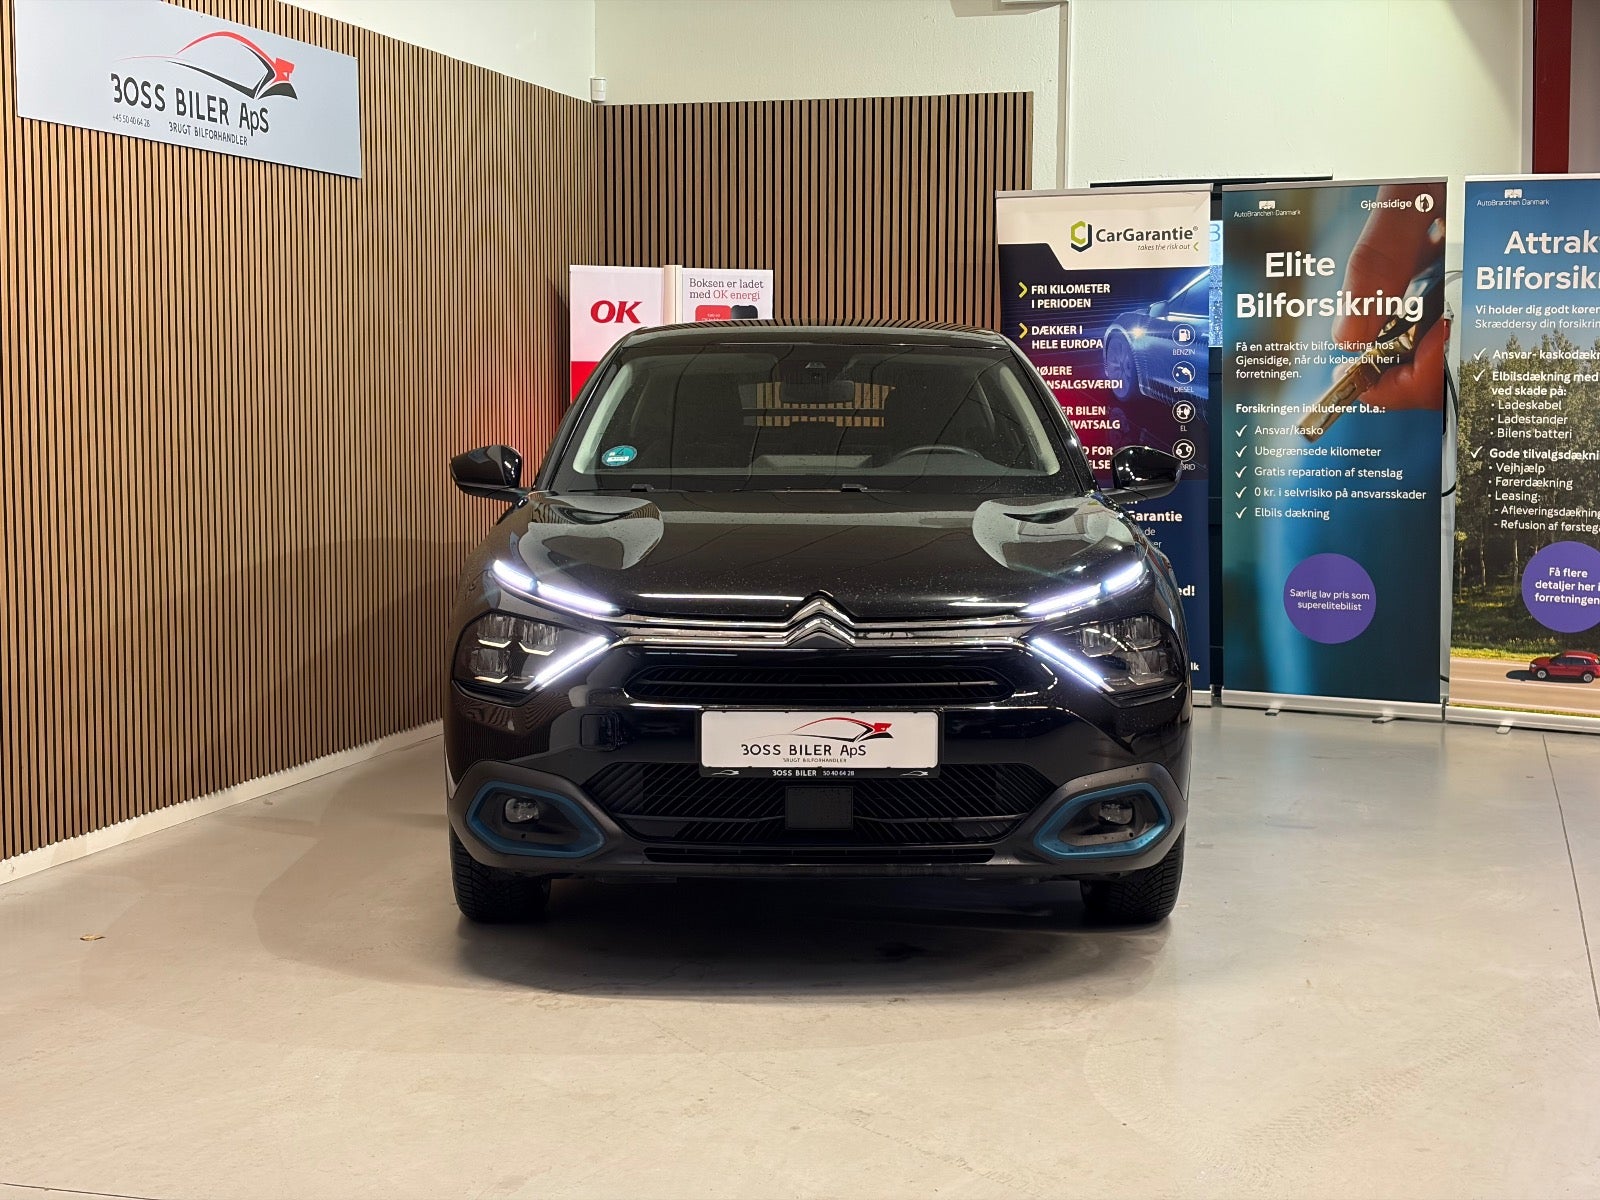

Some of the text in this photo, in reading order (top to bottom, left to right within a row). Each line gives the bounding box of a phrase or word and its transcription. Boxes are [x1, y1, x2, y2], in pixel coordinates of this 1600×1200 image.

[176, 89, 230, 126] BILER
[239, 102, 269, 136] ApS
[194, 126, 248, 146] BILFORHANDLER
[1360, 199, 1412, 211] Gjensidige
[1476, 198, 1550, 207] AutoBranchen Danmark
[1234, 209, 1301, 218] AutoBranchen Danmark
[1503, 229, 1600, 254] Attrak
[1266, 250, 1336, 278] Elite
[689, 278, 764, 289] Boksen er ladet
[1031, 284, 1111, 295] FRI KILOMETER
[689, 290, 761, 302] med OK energi
[1031, 298, 1091, 309] I PERIODEN
[1236, 289, 1424, 322] Bilforsikring
[590, 300, 643, 324] OK
[1475, 305, 1486, 315] Vi
[1488, 305, 1523, 315] holder
[1526, 305, 1542, 316] dig
[1544, 305, 1569, 316] godt
[1031, 325, 1083, 336] DÆKKER I
[1475, 319, 1537, 331] Skræddersy
[1539, 319, 1556, 329] din
[1031, 338, 1103, 349] HELE EUROPA
[1236, 342, 1247, 351] Få
[1264, 342, 1309, 351] attraktiv
[1311, 341, 1373, 353] bilforsikring
[1375, 341, 1394, 350] hos
[1236, 354, 1400, 366] Gjensidige, når du køber bil her i
[1492, 349, 1537, 360] Ansvar-
[1236, 369, 1302, 380] forretningen.
[1492, 371, 1599, 384] Elbilsdækning med
[1492, 386, 1567, 398] ved skade på:
[1075, 406, 1106, 416] BILEN
[1236, 403, 1386, 415] Forsikringen inkluderer bl.a.:
[1498, 400, 1562, 410] Ladeskabel
[1497, 414, 1568, 425] Ladestander
[1255, 425, 1324, 435] Ansvar/kasko
[1497, 428, 1572, 439] Bilens batteri
[1092, 446, 1113, 456] FOR
[1255, 446, 1381, 458] Ubegrænsede kilometer
[1489, 448, 1520, 459] Gode
[1254, 467, 1403, 480] Gratis reparation af stenslag
[1496, 463, 1545, 475] Vejhjælp
[1495, 476, 1573, 491] Førerdækning
[1254, 487, 1261, 497] 0
[1263, 487, 1276, 497] kr.
[1284, 488, 1333, 497] selvrisiko
[1335, 488, 1349, 500] på
[1351, 489, 1427, 500] ansvarsskader
[1495, 491, 1541, 503] Leasing:
[1255, 508, 1330, 520] Elbils dækning
[1500, 520, 1546, 530] Refusion
[1548, 521, 1558, 531] af
[1549, 567, 1588, 578] Få flere
[1535, 580, 1576, 592] detaljer
[1577, 581, 1595, 592] her
[1289, 588, 1370, 602] Særlig lav pris som
[1297, 601, 1362, 612] superelitebilist
[789, 744, 832, 756] BILER
[839, 744, 867, 758] ApS
[795, 769, 817, 777] BILER
